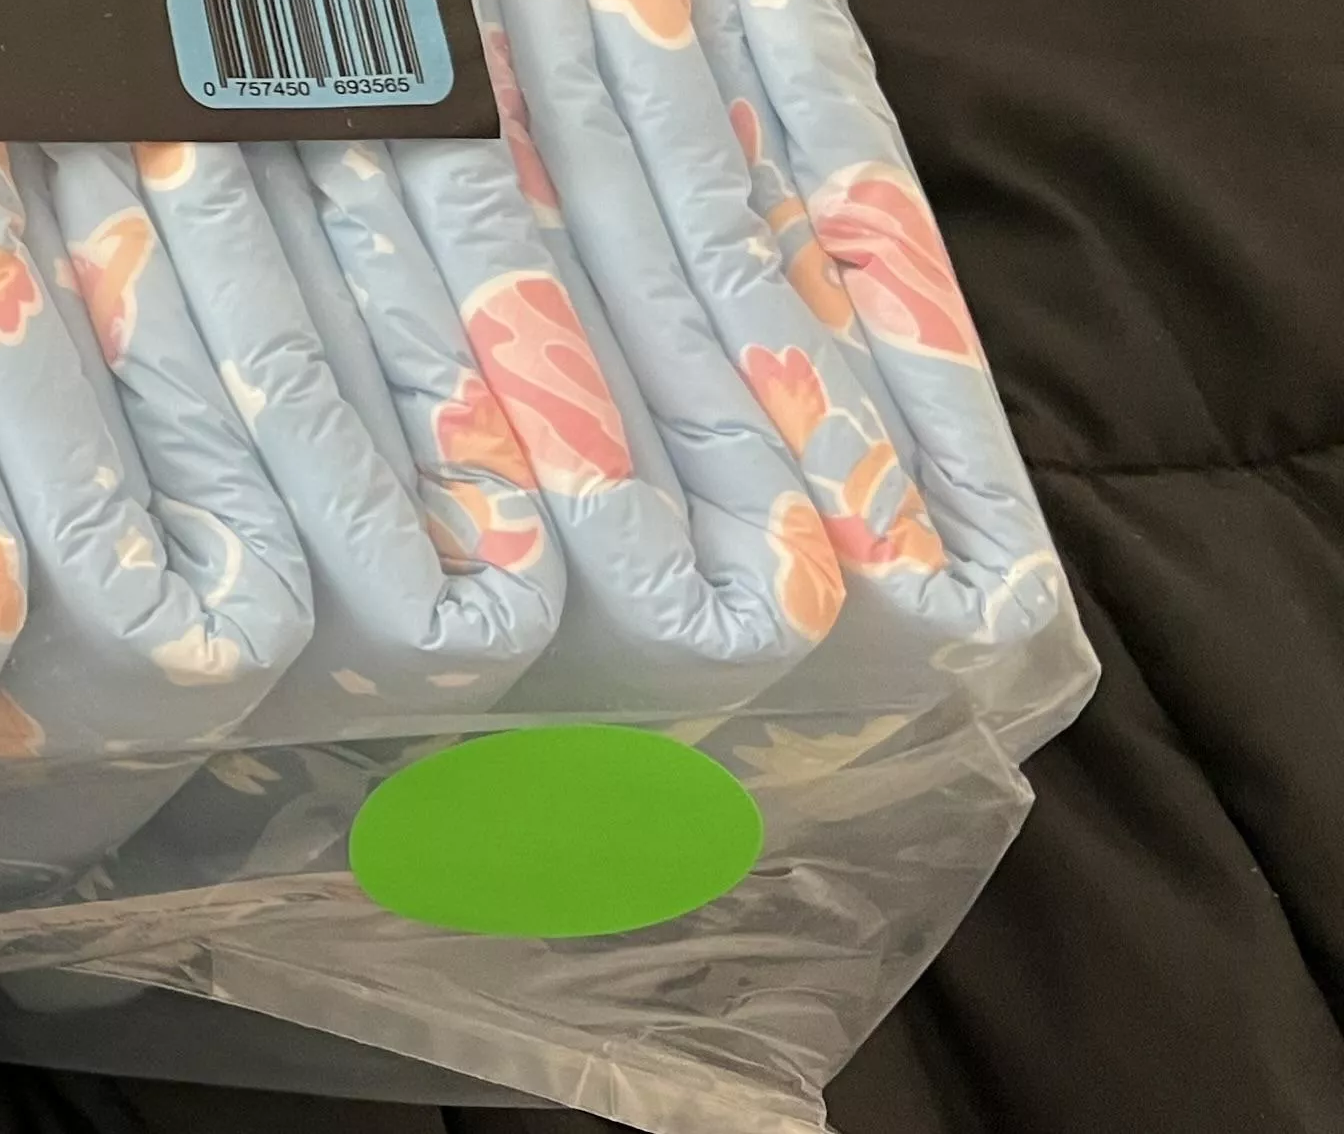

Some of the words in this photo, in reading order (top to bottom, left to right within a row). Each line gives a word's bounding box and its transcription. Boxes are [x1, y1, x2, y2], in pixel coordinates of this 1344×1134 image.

[204, 81, 216, 97] 0
[235, 81, 311, 97] 757450
[334, 78, 411, 95] 693565
